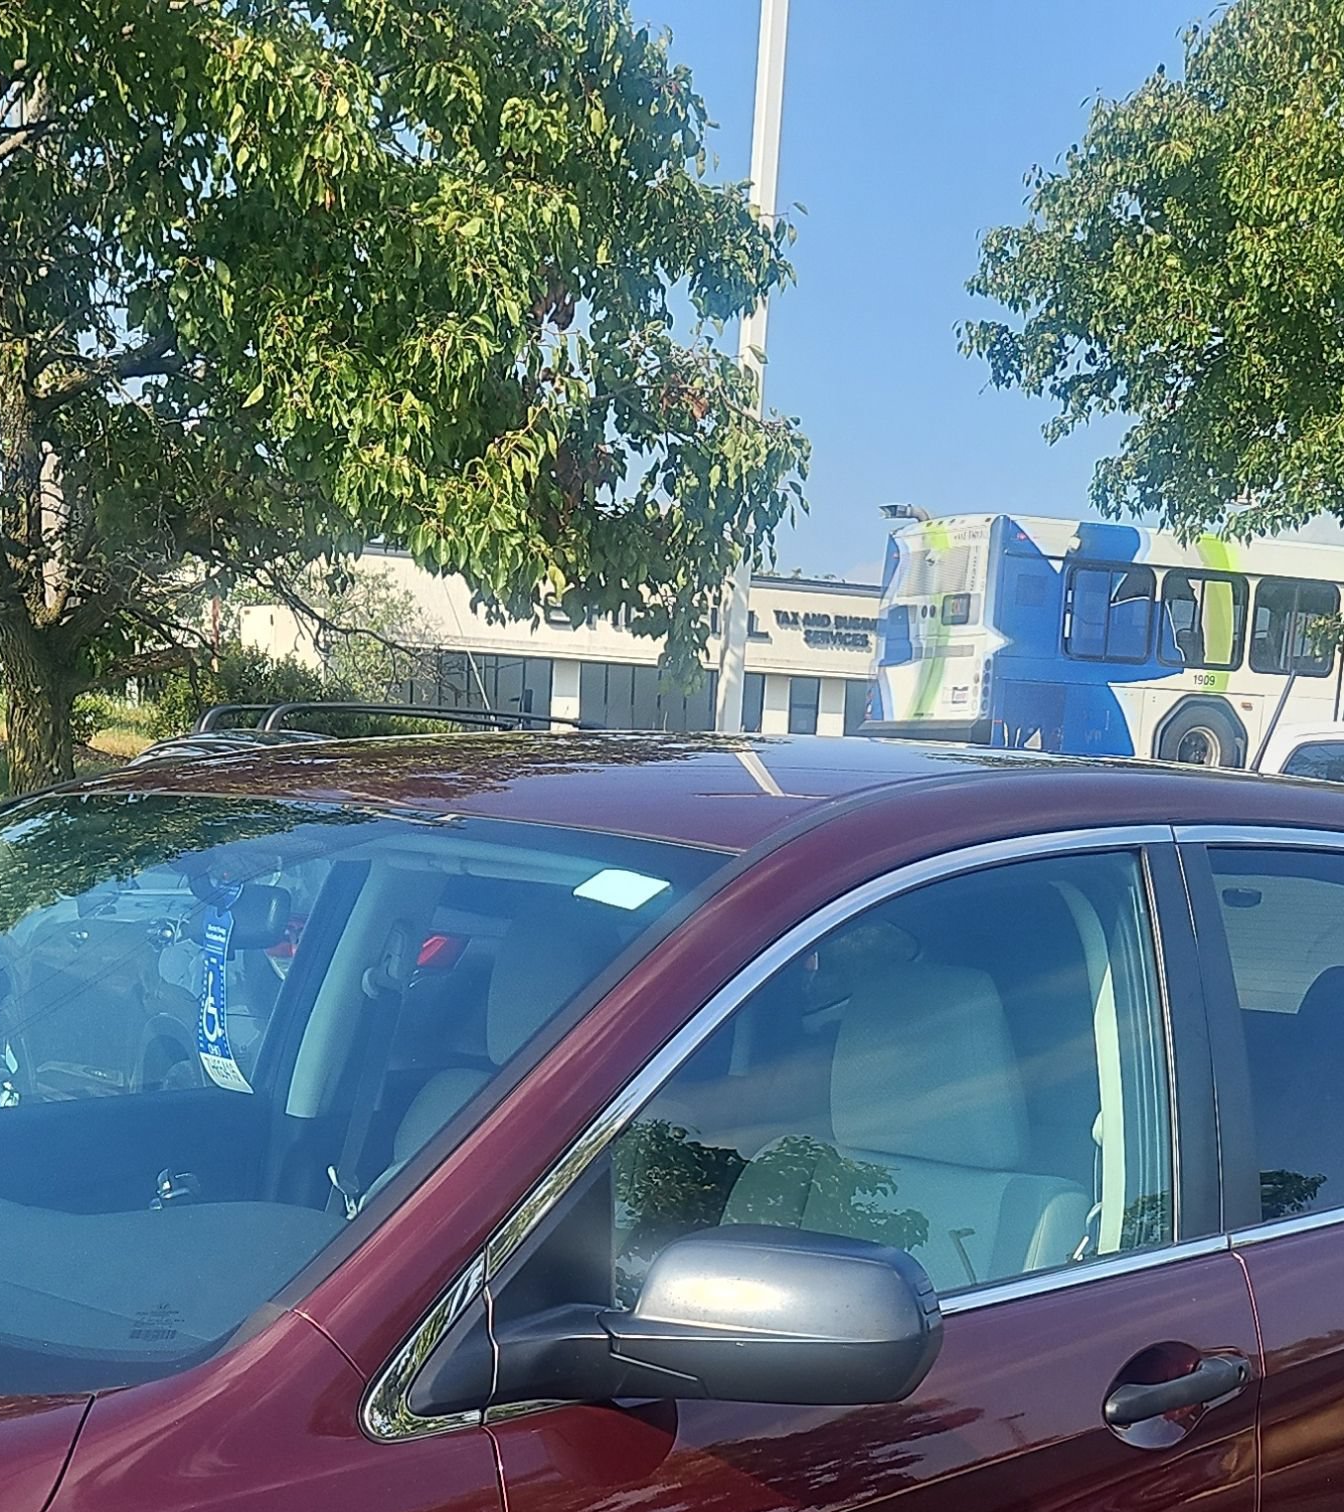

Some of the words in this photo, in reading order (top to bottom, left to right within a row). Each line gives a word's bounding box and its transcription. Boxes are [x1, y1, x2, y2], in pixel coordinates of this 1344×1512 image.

[773, 609, 800, 627] TAX
[802, 612, 831, 628] AND
[804, 630, 870, 649] SERVICES
[1193, 674, 1216, 686] 1909
